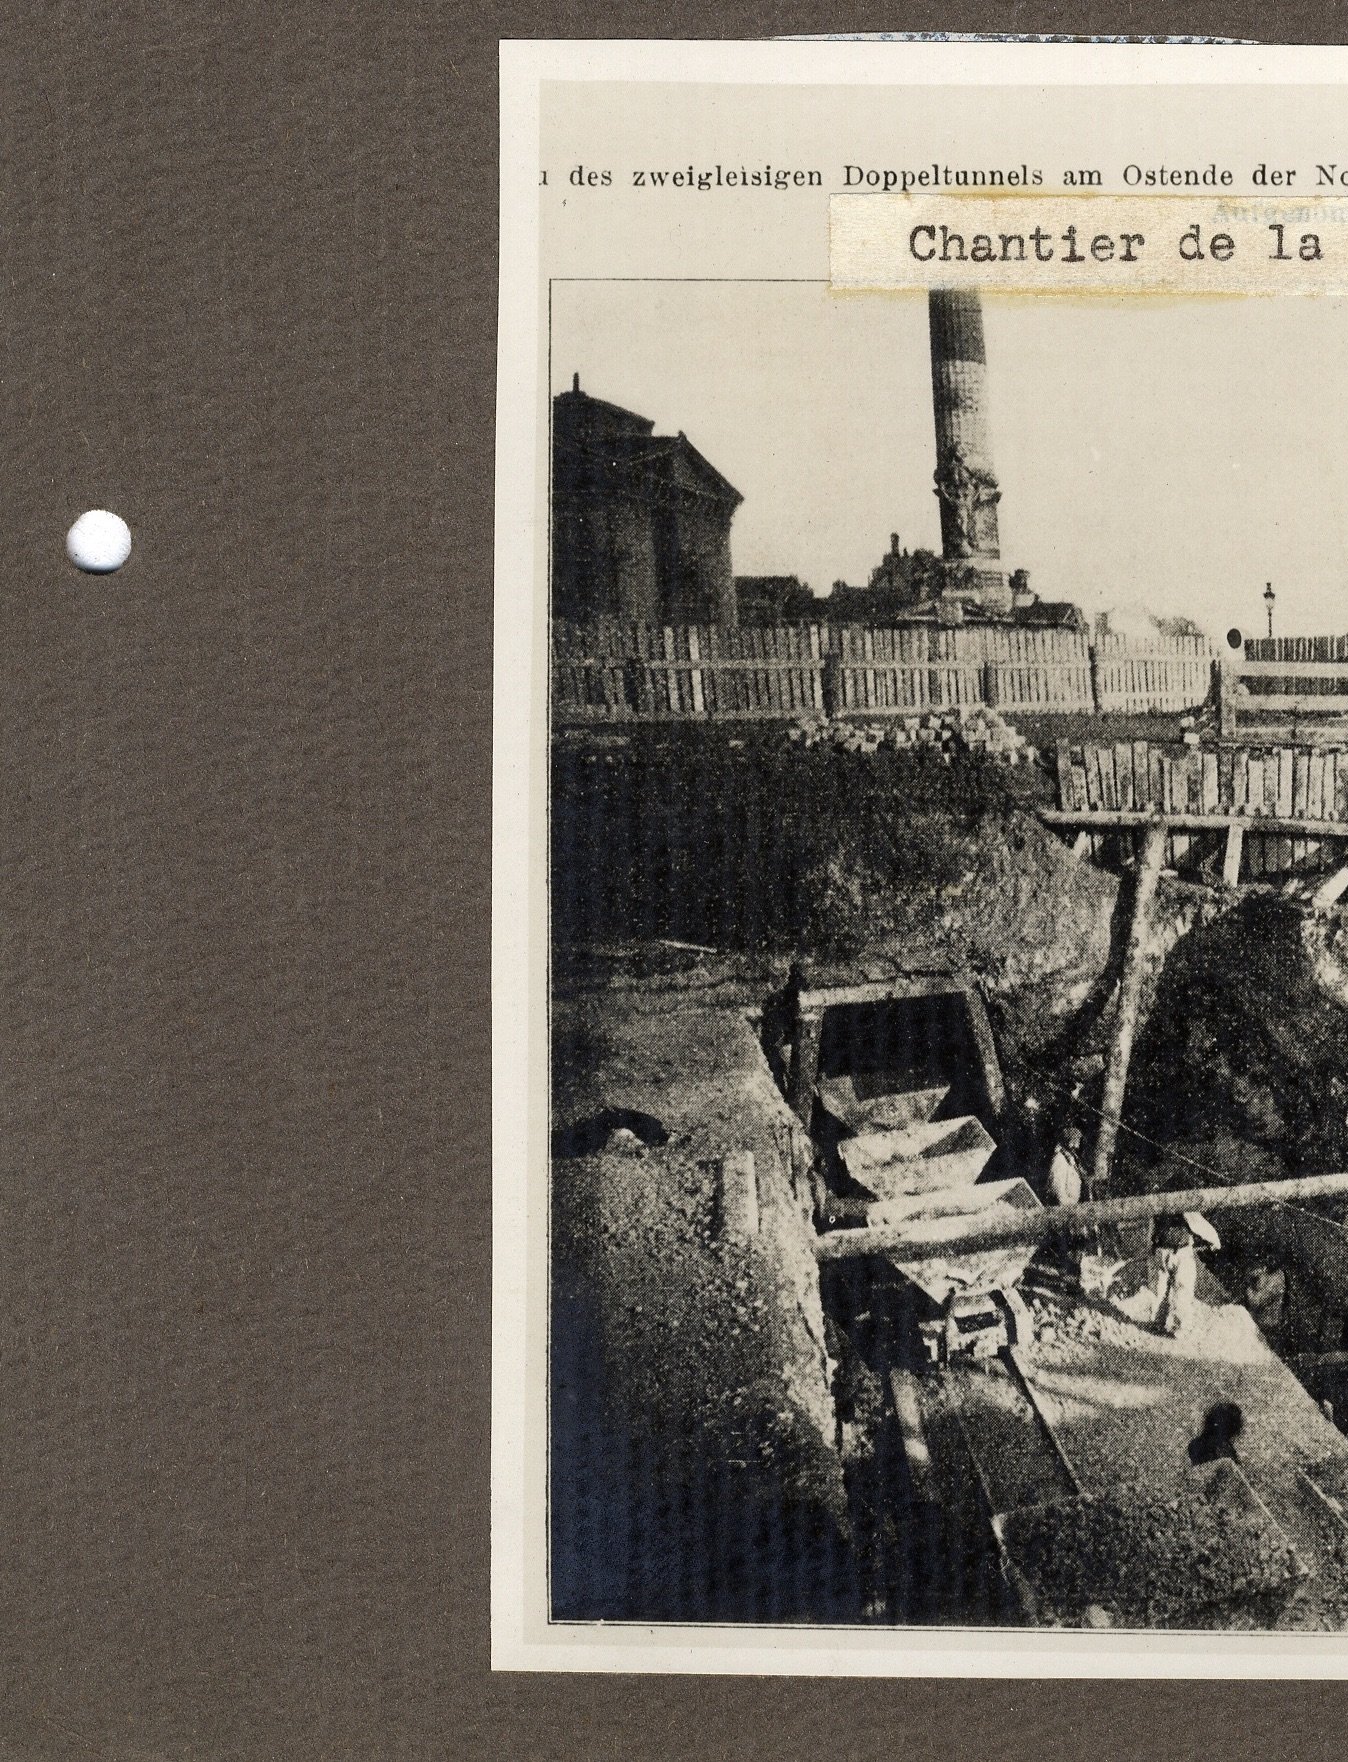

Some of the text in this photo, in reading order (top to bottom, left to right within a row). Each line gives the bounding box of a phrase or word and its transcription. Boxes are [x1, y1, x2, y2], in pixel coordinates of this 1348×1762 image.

[569, 165, 613, 187] des
[632, 164, 823, 191] zweigleisigen
[843, 163, 1043, 193] Doppeltunnels
[1063, 170, 1103, 186] am
[1122, 164, 1233, 186] Ostende
[1252, 163, 1297, 186] der
[909, 224, 1145, 264] Chantier
[1178, 224, 1236, 262] de
[1268, 223, 1324, 262] la
